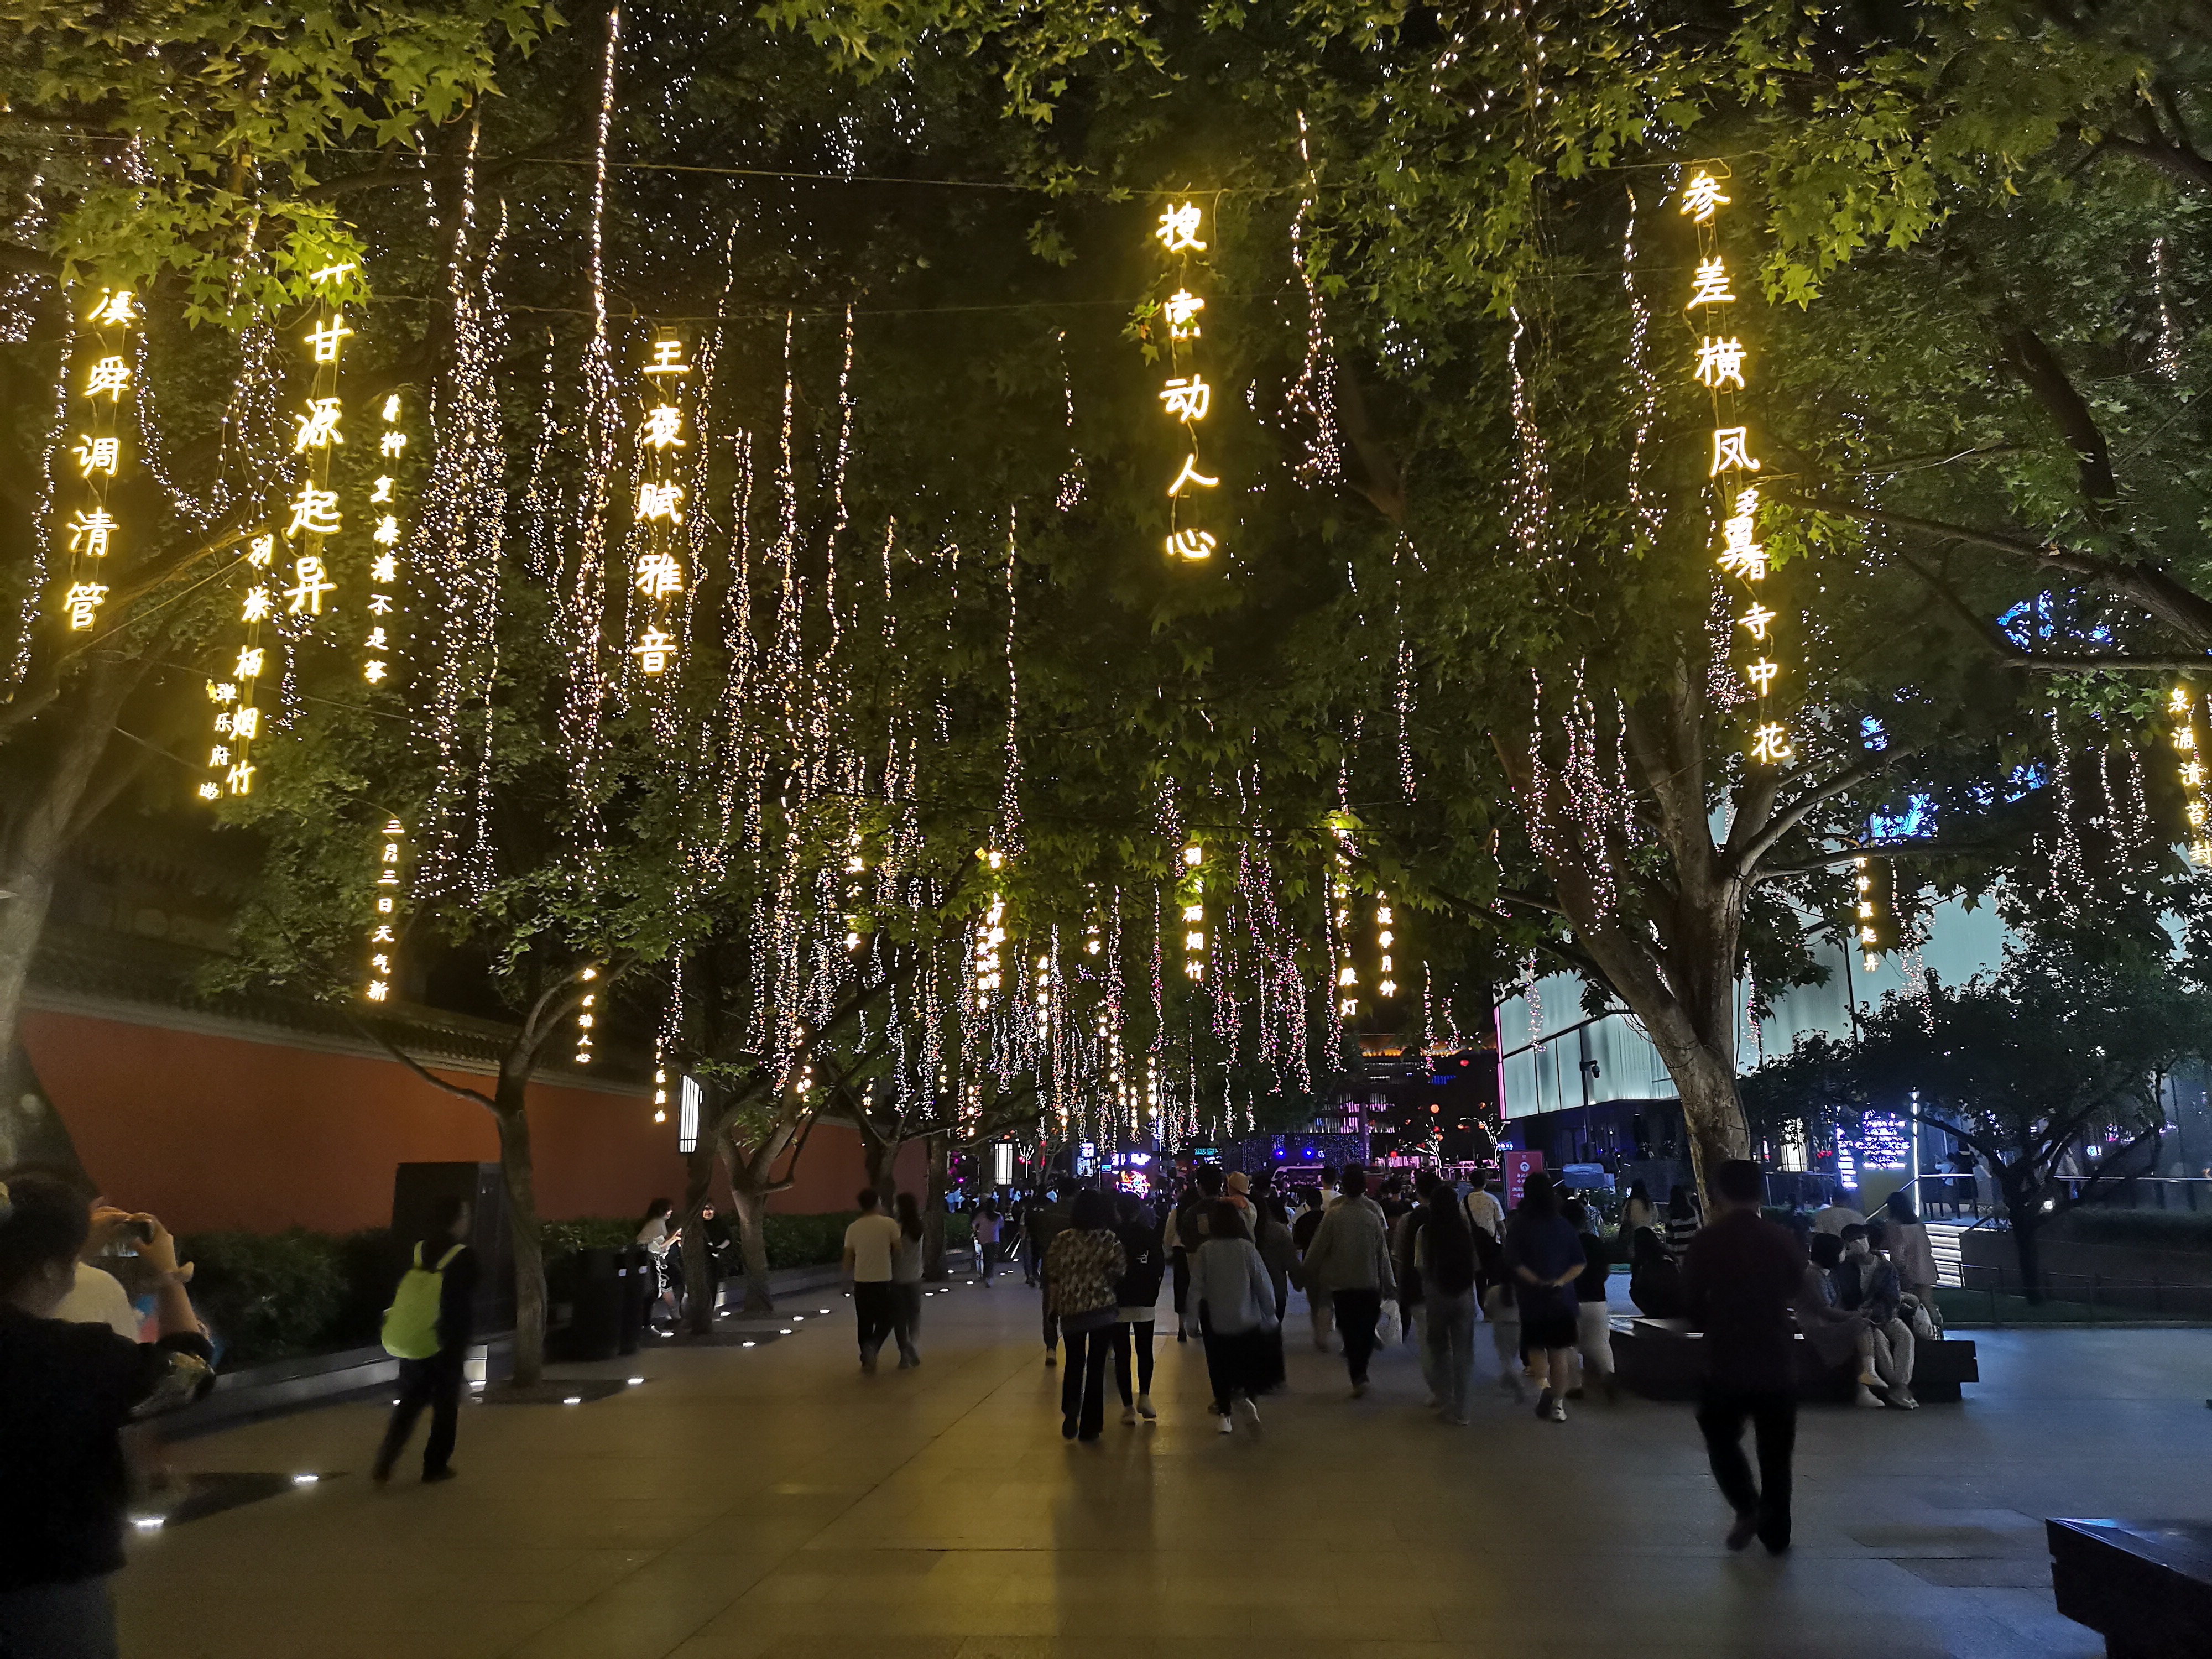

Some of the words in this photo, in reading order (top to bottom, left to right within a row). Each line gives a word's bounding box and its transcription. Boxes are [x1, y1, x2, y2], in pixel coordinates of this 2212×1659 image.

[631, 341, 690, 675] 王褒赋雅音
[1156, 201, 1219, 559] 搜索动人心
[366, 818, 405, 1003] 三月三日天气新
[1182, 847, 1204, 979] 羽栖烟竹
